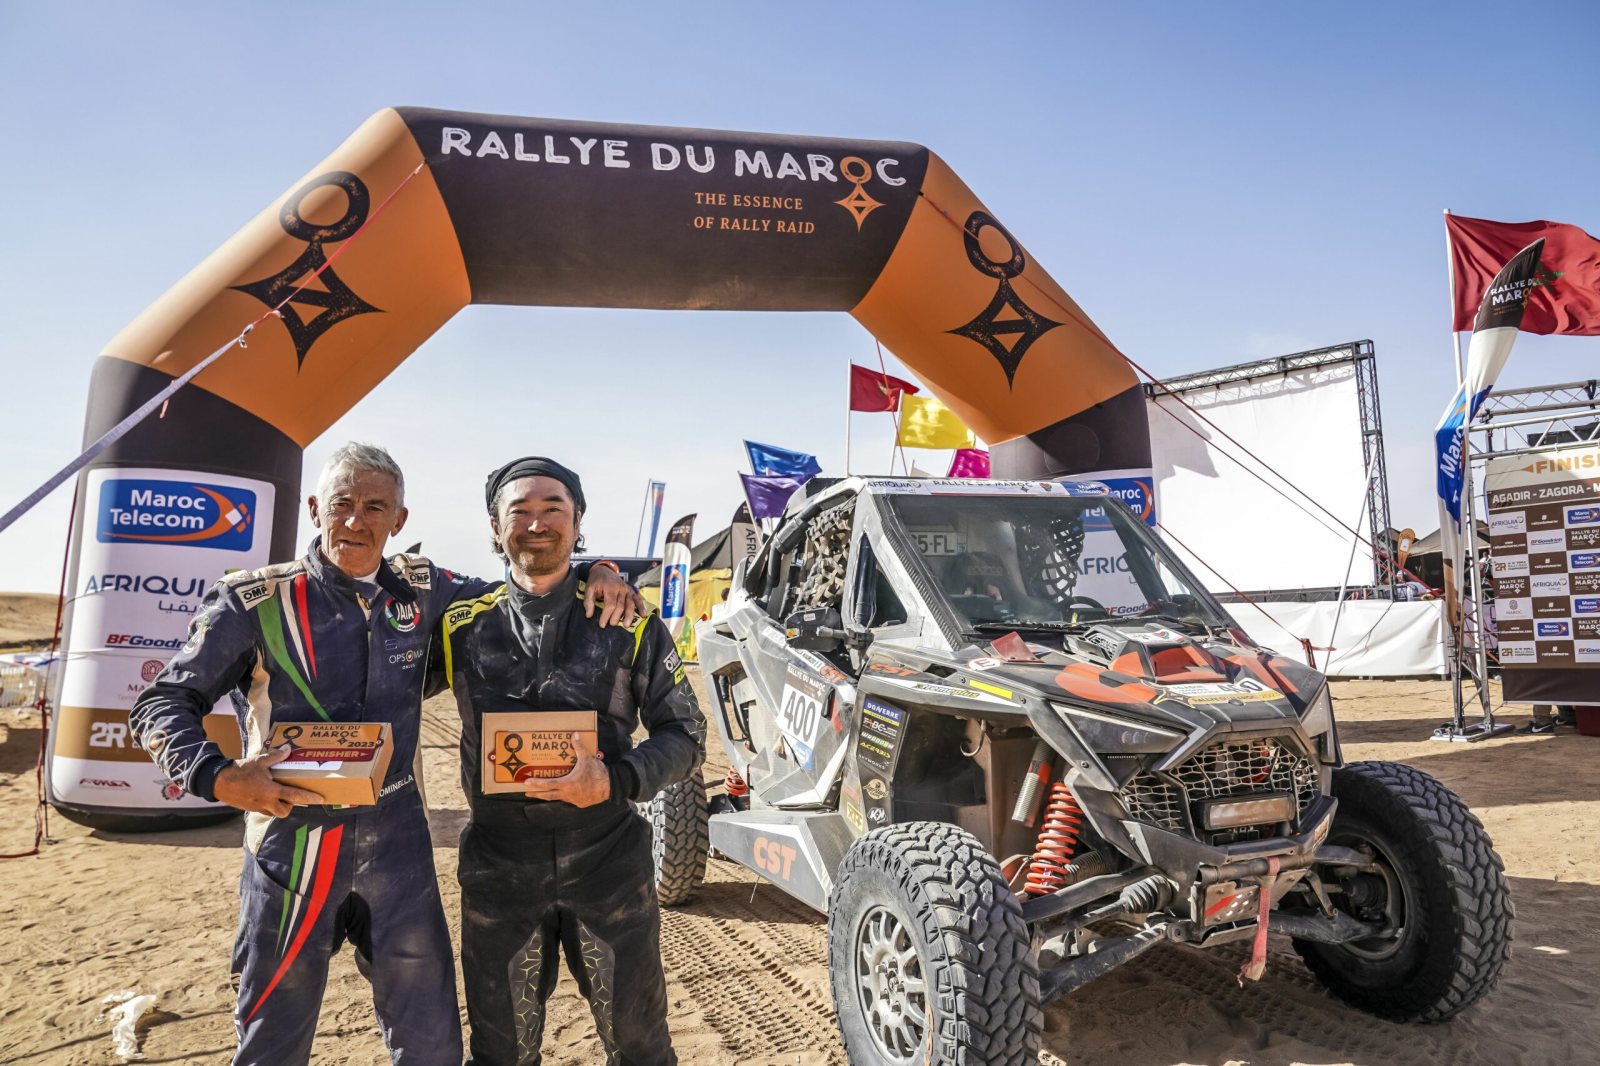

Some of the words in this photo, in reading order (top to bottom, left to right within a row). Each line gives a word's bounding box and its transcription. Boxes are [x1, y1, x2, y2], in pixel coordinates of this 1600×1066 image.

[441, 126, 631, 168] RALLYE
[651, 142, 715, 174] DU
[735, 149, 906, 187] MAROC
[694, 192, 728, 207] THE
[733, 194, 804, 211] ESSENCE
[693, 216, 714, 231] OF
[720, 217, 771, 234] RALLY
[776, 220, 815, 235] RAID
[1490, 280, 1525, 295] RALLYE
[1440, 425, 1464, 479] Maro
[130, 490, 206, 510] Maroc
[1113, 488, 1140, 499] aroc
[1492, 490, 1531, 504] AGADIR
[1538, 484, 1584, 498] ZAGORA
[110, 508, 205, 529] Telecom
[84, 574, 205, 598] AFRIQUI
[410, 573, 430, 583] OMP
[243, 586, 268, 600] OMP
[450, 610, 471, 624] OMP
[106, 633, 187, 648] BFGoodr
[665, 650, 681, 670] OM
[783, 690, 816, 743] 400
[379, 774, 415, 797] OMINELLA
[753, 837, 797, 881] CST
